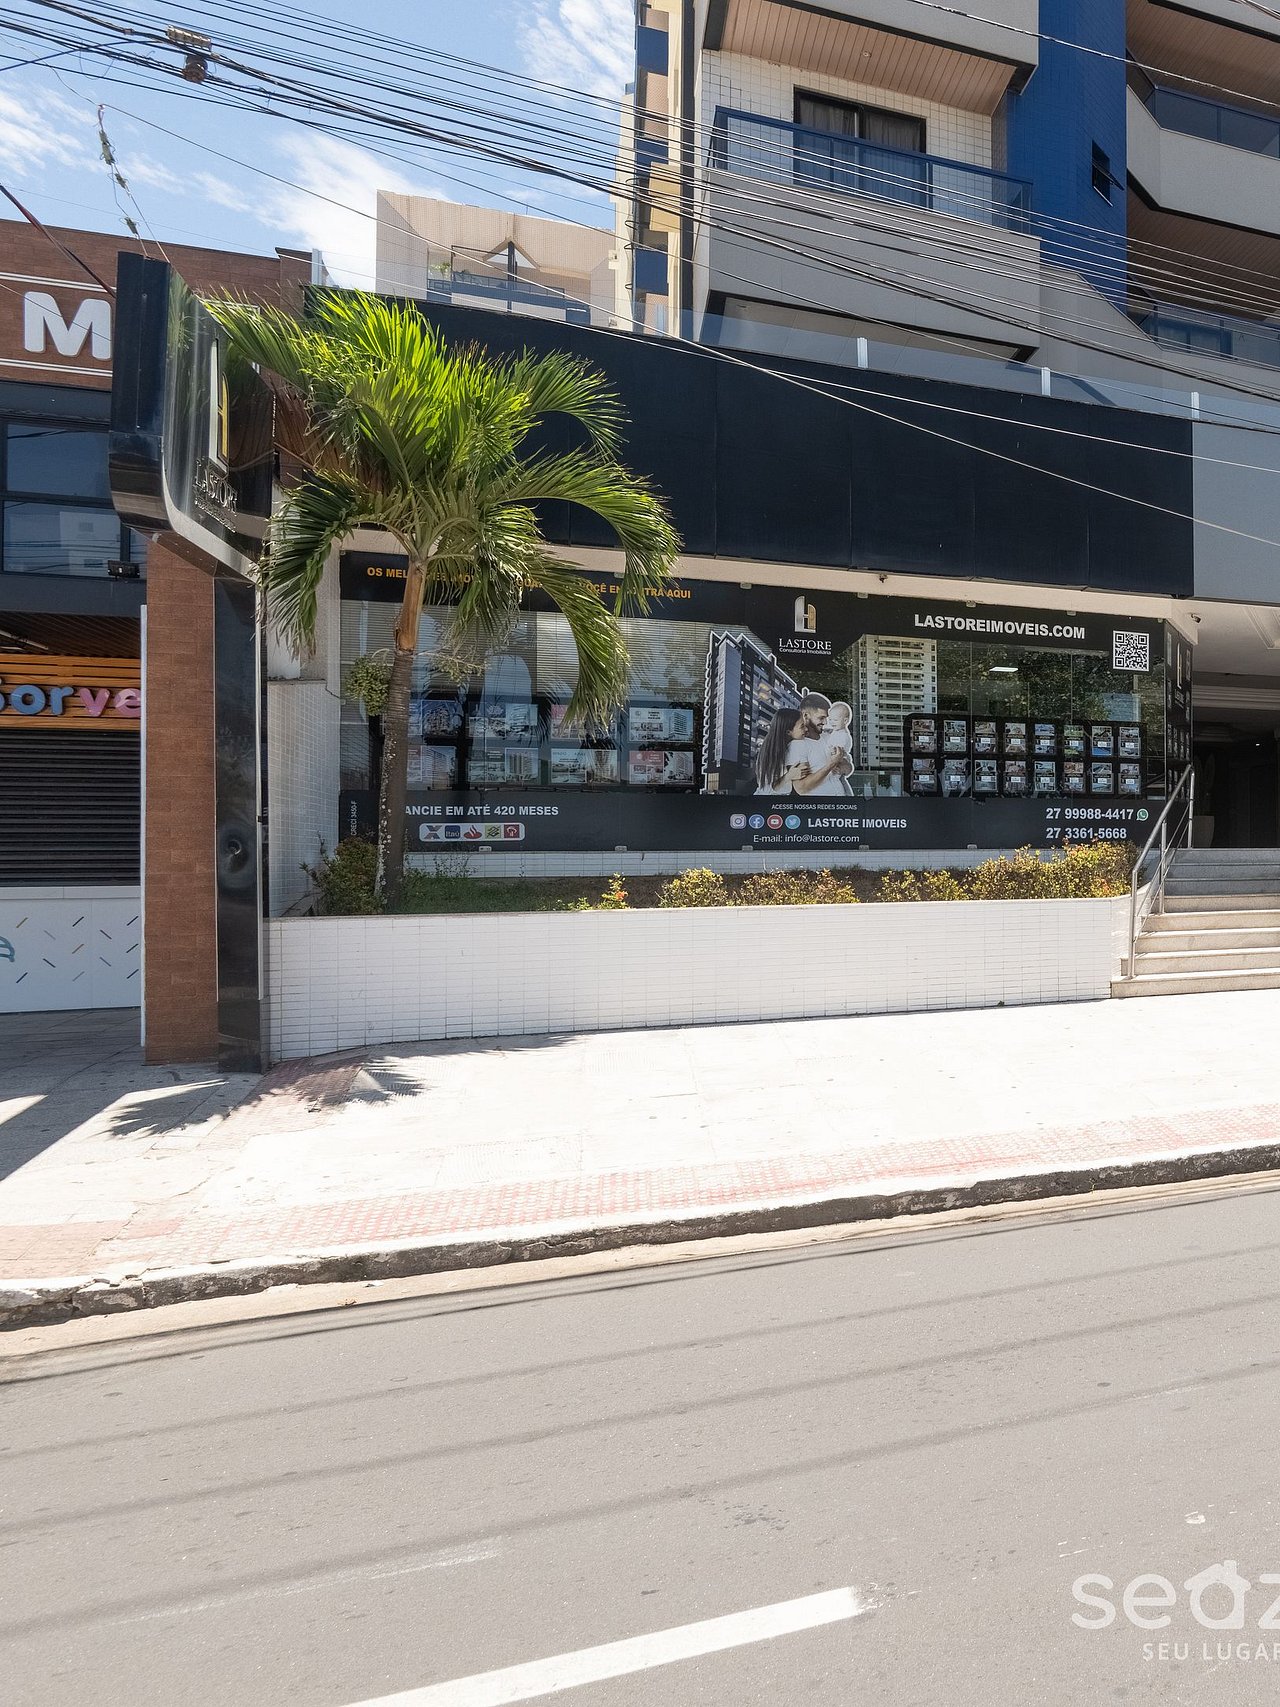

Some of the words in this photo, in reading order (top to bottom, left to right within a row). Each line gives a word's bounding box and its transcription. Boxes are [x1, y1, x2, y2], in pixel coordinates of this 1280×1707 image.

[366, 566, 383, 577] OS
[666, 588, 692, 600] AQUI
[914, 613, 1086, 640] LASTOREIMOVEIS.COM
[778, 638, 832, 651] LASTORE
[0, 683, 141, 717] orve
[445, 805, 464, 816] EM
[467, 803, 491, 816] ATÉ
[494, 805, 515, 816] 420
[518, 805, 560, 816] MESES
[1045, 807, 1061, 820] 27
[1064, 807, 1134, 821] 99988-4417
[807, 817, 860, 829] LASTORE
[862, 818, 908, 829] IMOVEIS
[753, 834, 783, 843] E-mail:
[784, 834, 860, 843] info@lastore.com
[1045, 827, 1061, 839] 27
[1064, 827, 1128, 840] 3361-5668
